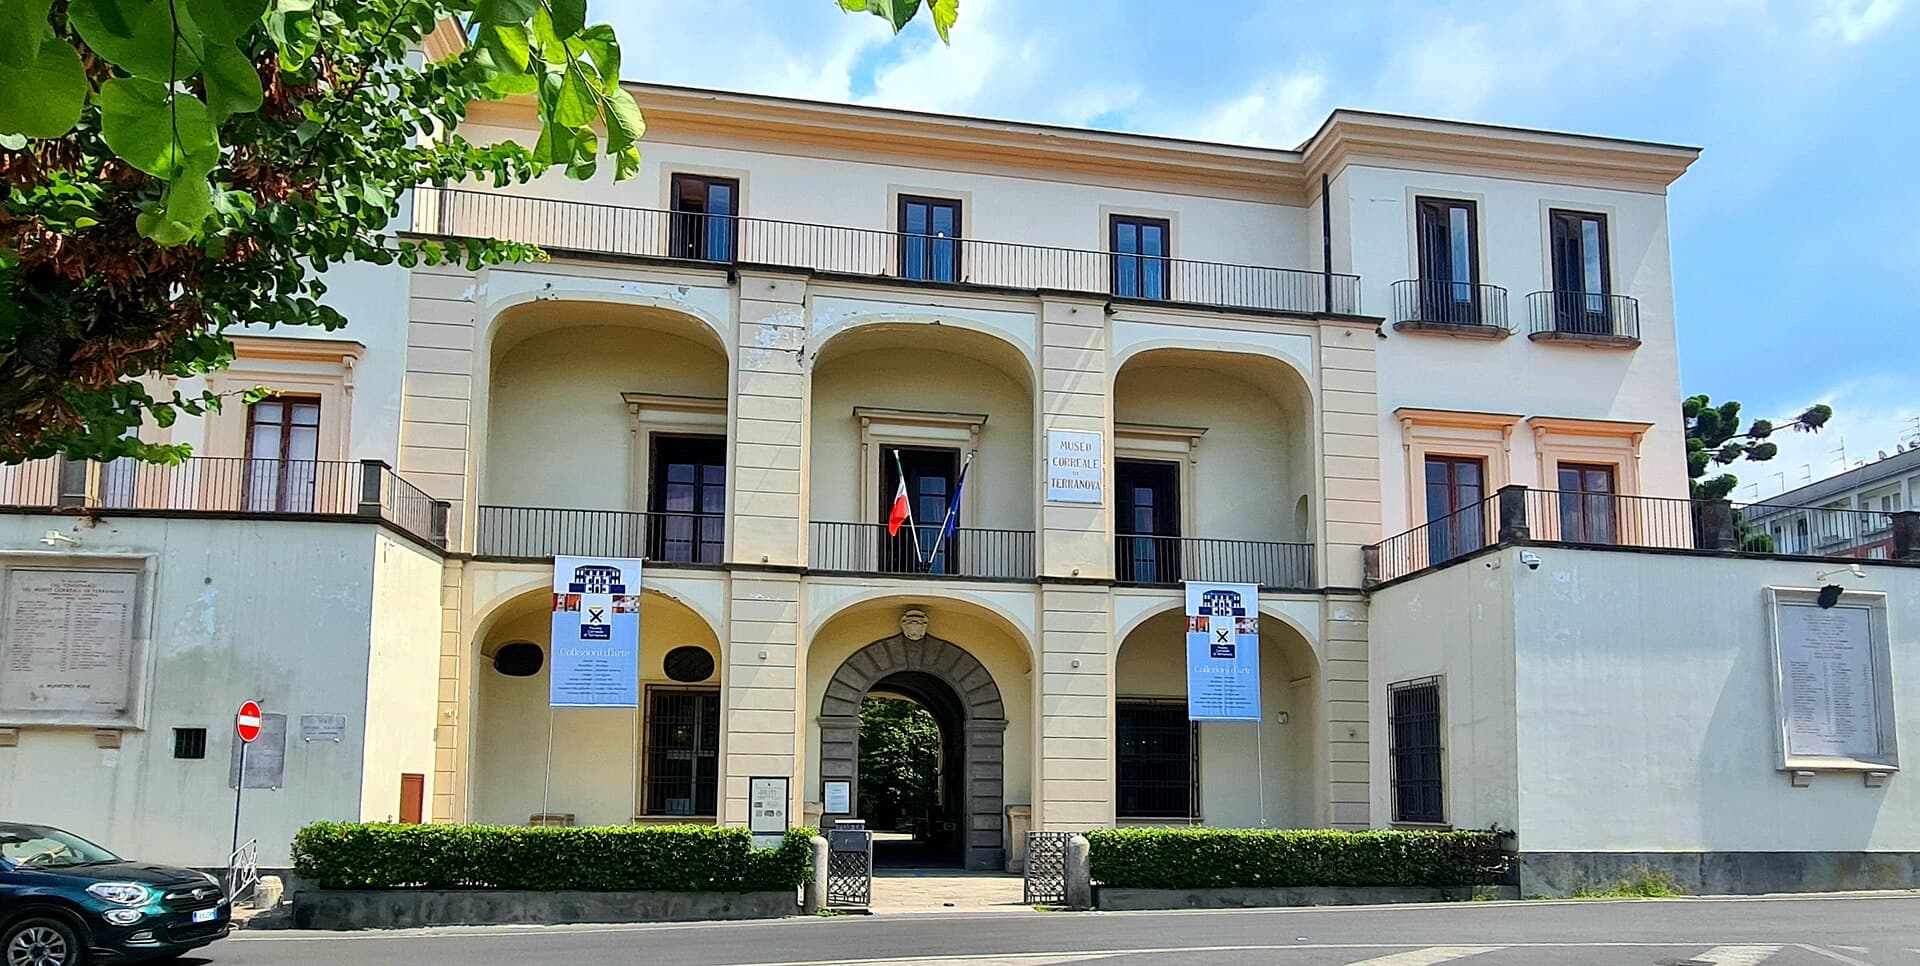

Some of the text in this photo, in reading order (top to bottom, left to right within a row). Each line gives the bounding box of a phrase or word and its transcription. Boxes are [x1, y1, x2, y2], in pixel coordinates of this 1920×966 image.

[1060, 441, 1092, 452] MUSEO
[1052, 457, 1100, 469] CORREALE
[1051, 478, 1101, 490] TERRANOVA
